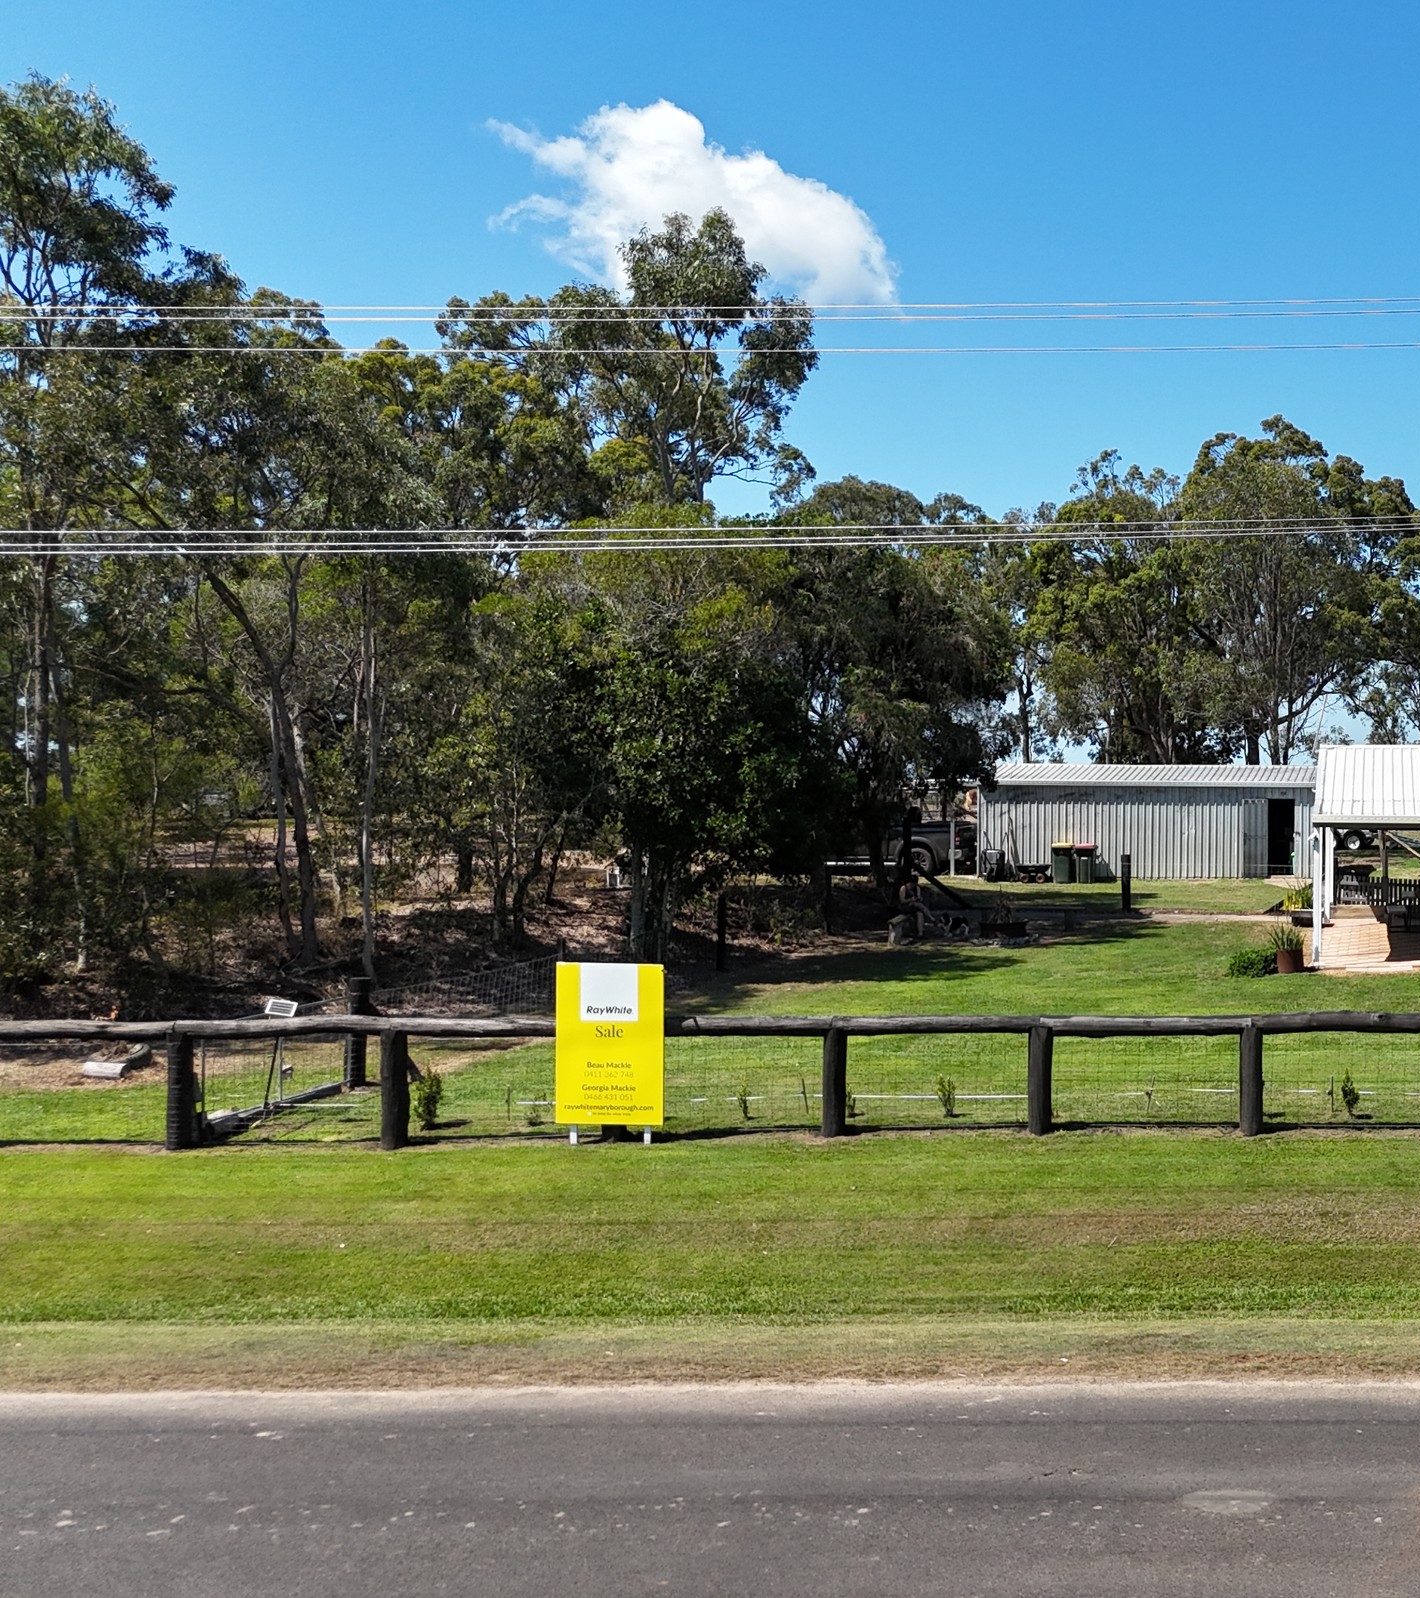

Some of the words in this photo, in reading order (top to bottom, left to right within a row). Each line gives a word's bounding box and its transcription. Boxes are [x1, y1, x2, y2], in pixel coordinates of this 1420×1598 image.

[595, 1024, 624, 1038] Sale
[586, 1061, 605, 1069] Beau
[606, 1061, 632, 1069] Mackie
[581, 1084, 610, 1092] Georgia
[610, 1084, 637, 1092] Mackie
[604, 1093, 618, 1101] 431
[619, 1093, 634, 1101] 051
[564, 1103, 654, 1112] raywhitemaryborough.com
